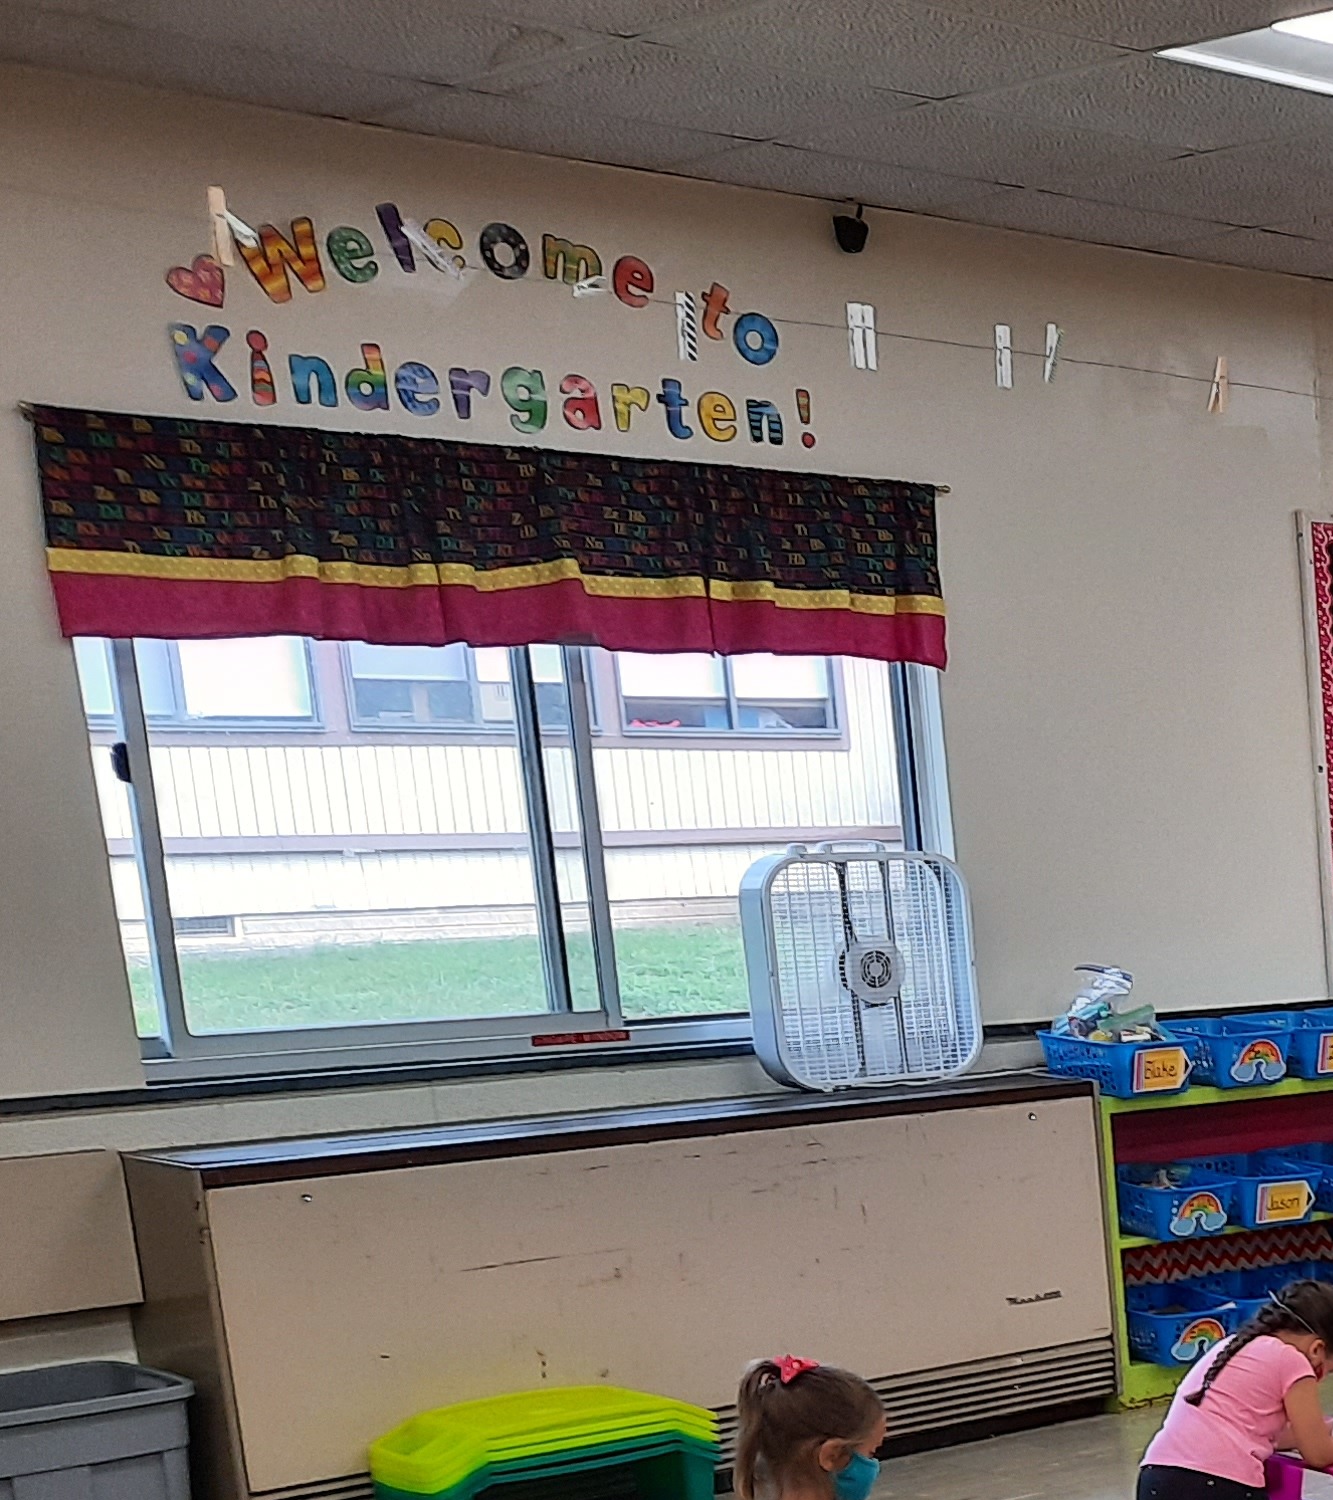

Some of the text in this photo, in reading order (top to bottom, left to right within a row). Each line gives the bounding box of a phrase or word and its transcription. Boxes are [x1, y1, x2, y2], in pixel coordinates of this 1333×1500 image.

[234, 202, 778, 365] Welcome to
[169, 322, 816, 448] Kindergarten!
